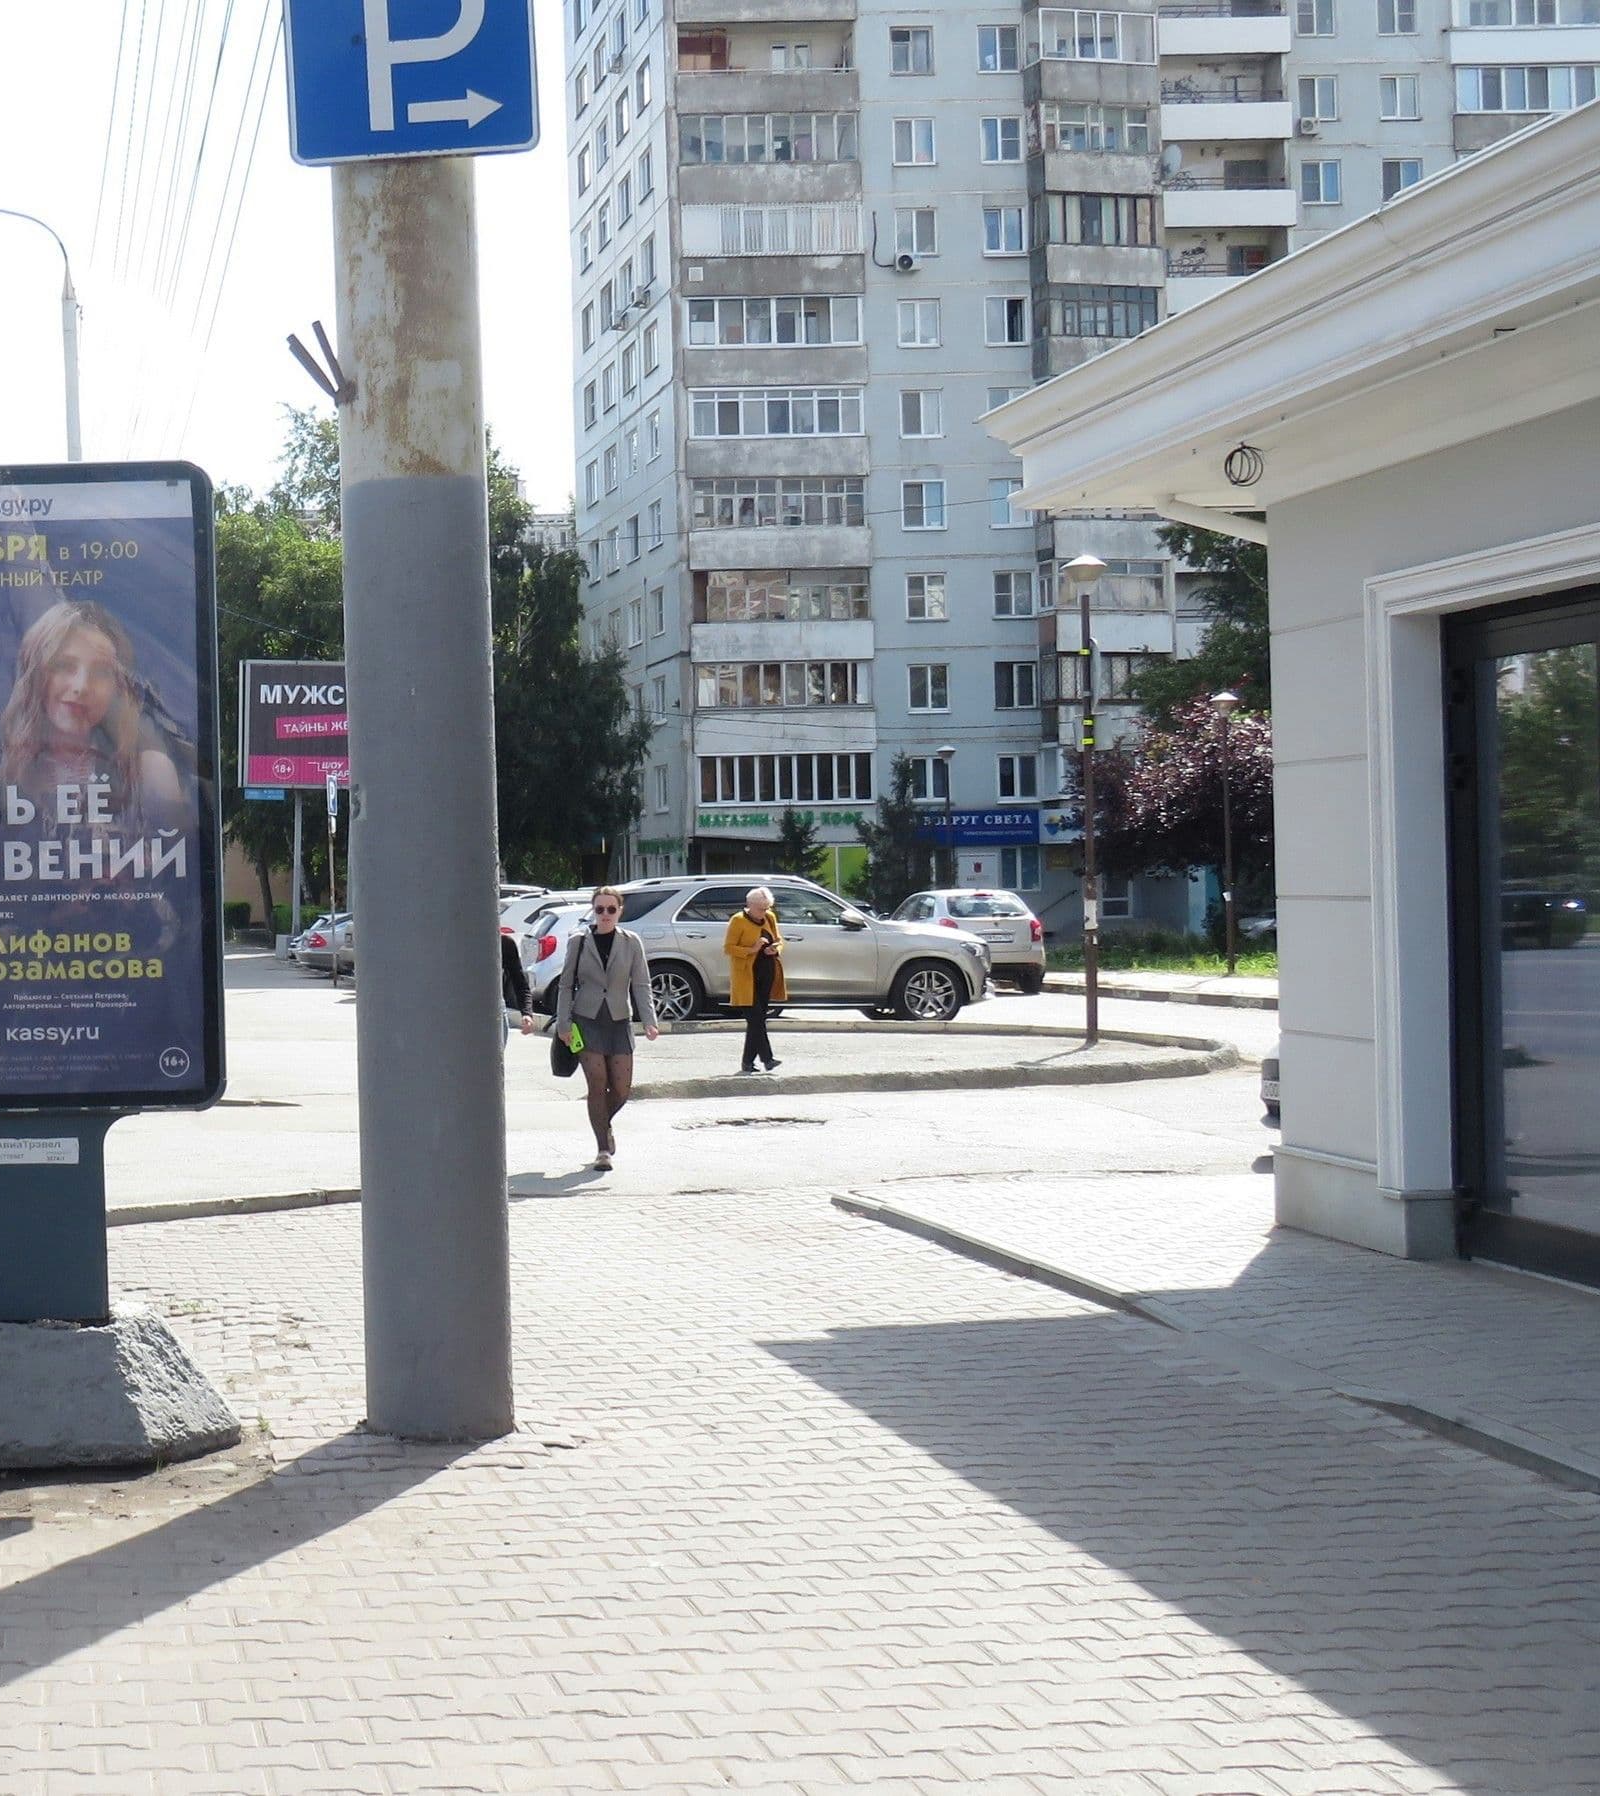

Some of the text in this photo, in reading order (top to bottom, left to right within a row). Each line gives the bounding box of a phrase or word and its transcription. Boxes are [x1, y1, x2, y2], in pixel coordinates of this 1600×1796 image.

[364, 0, 485, 131] P
[80, 541, 139, 560] 19:00
[50, 570, 104, 587] ТЕАТР
[283, 720, 328, 734] ТАЙНЫ
[275, 763, 292, 773] 18+
[56, 773, 114, 824] ЕЁ
[984, 813, 1033, 825] СВЕТА
[31, 892, 101, 904] авантюрную
[103, 891, 165, 904] мелодраму
[6, 1025, 100, 1046] kassy.ru
[163, 1056, 186, 1067] 16+
